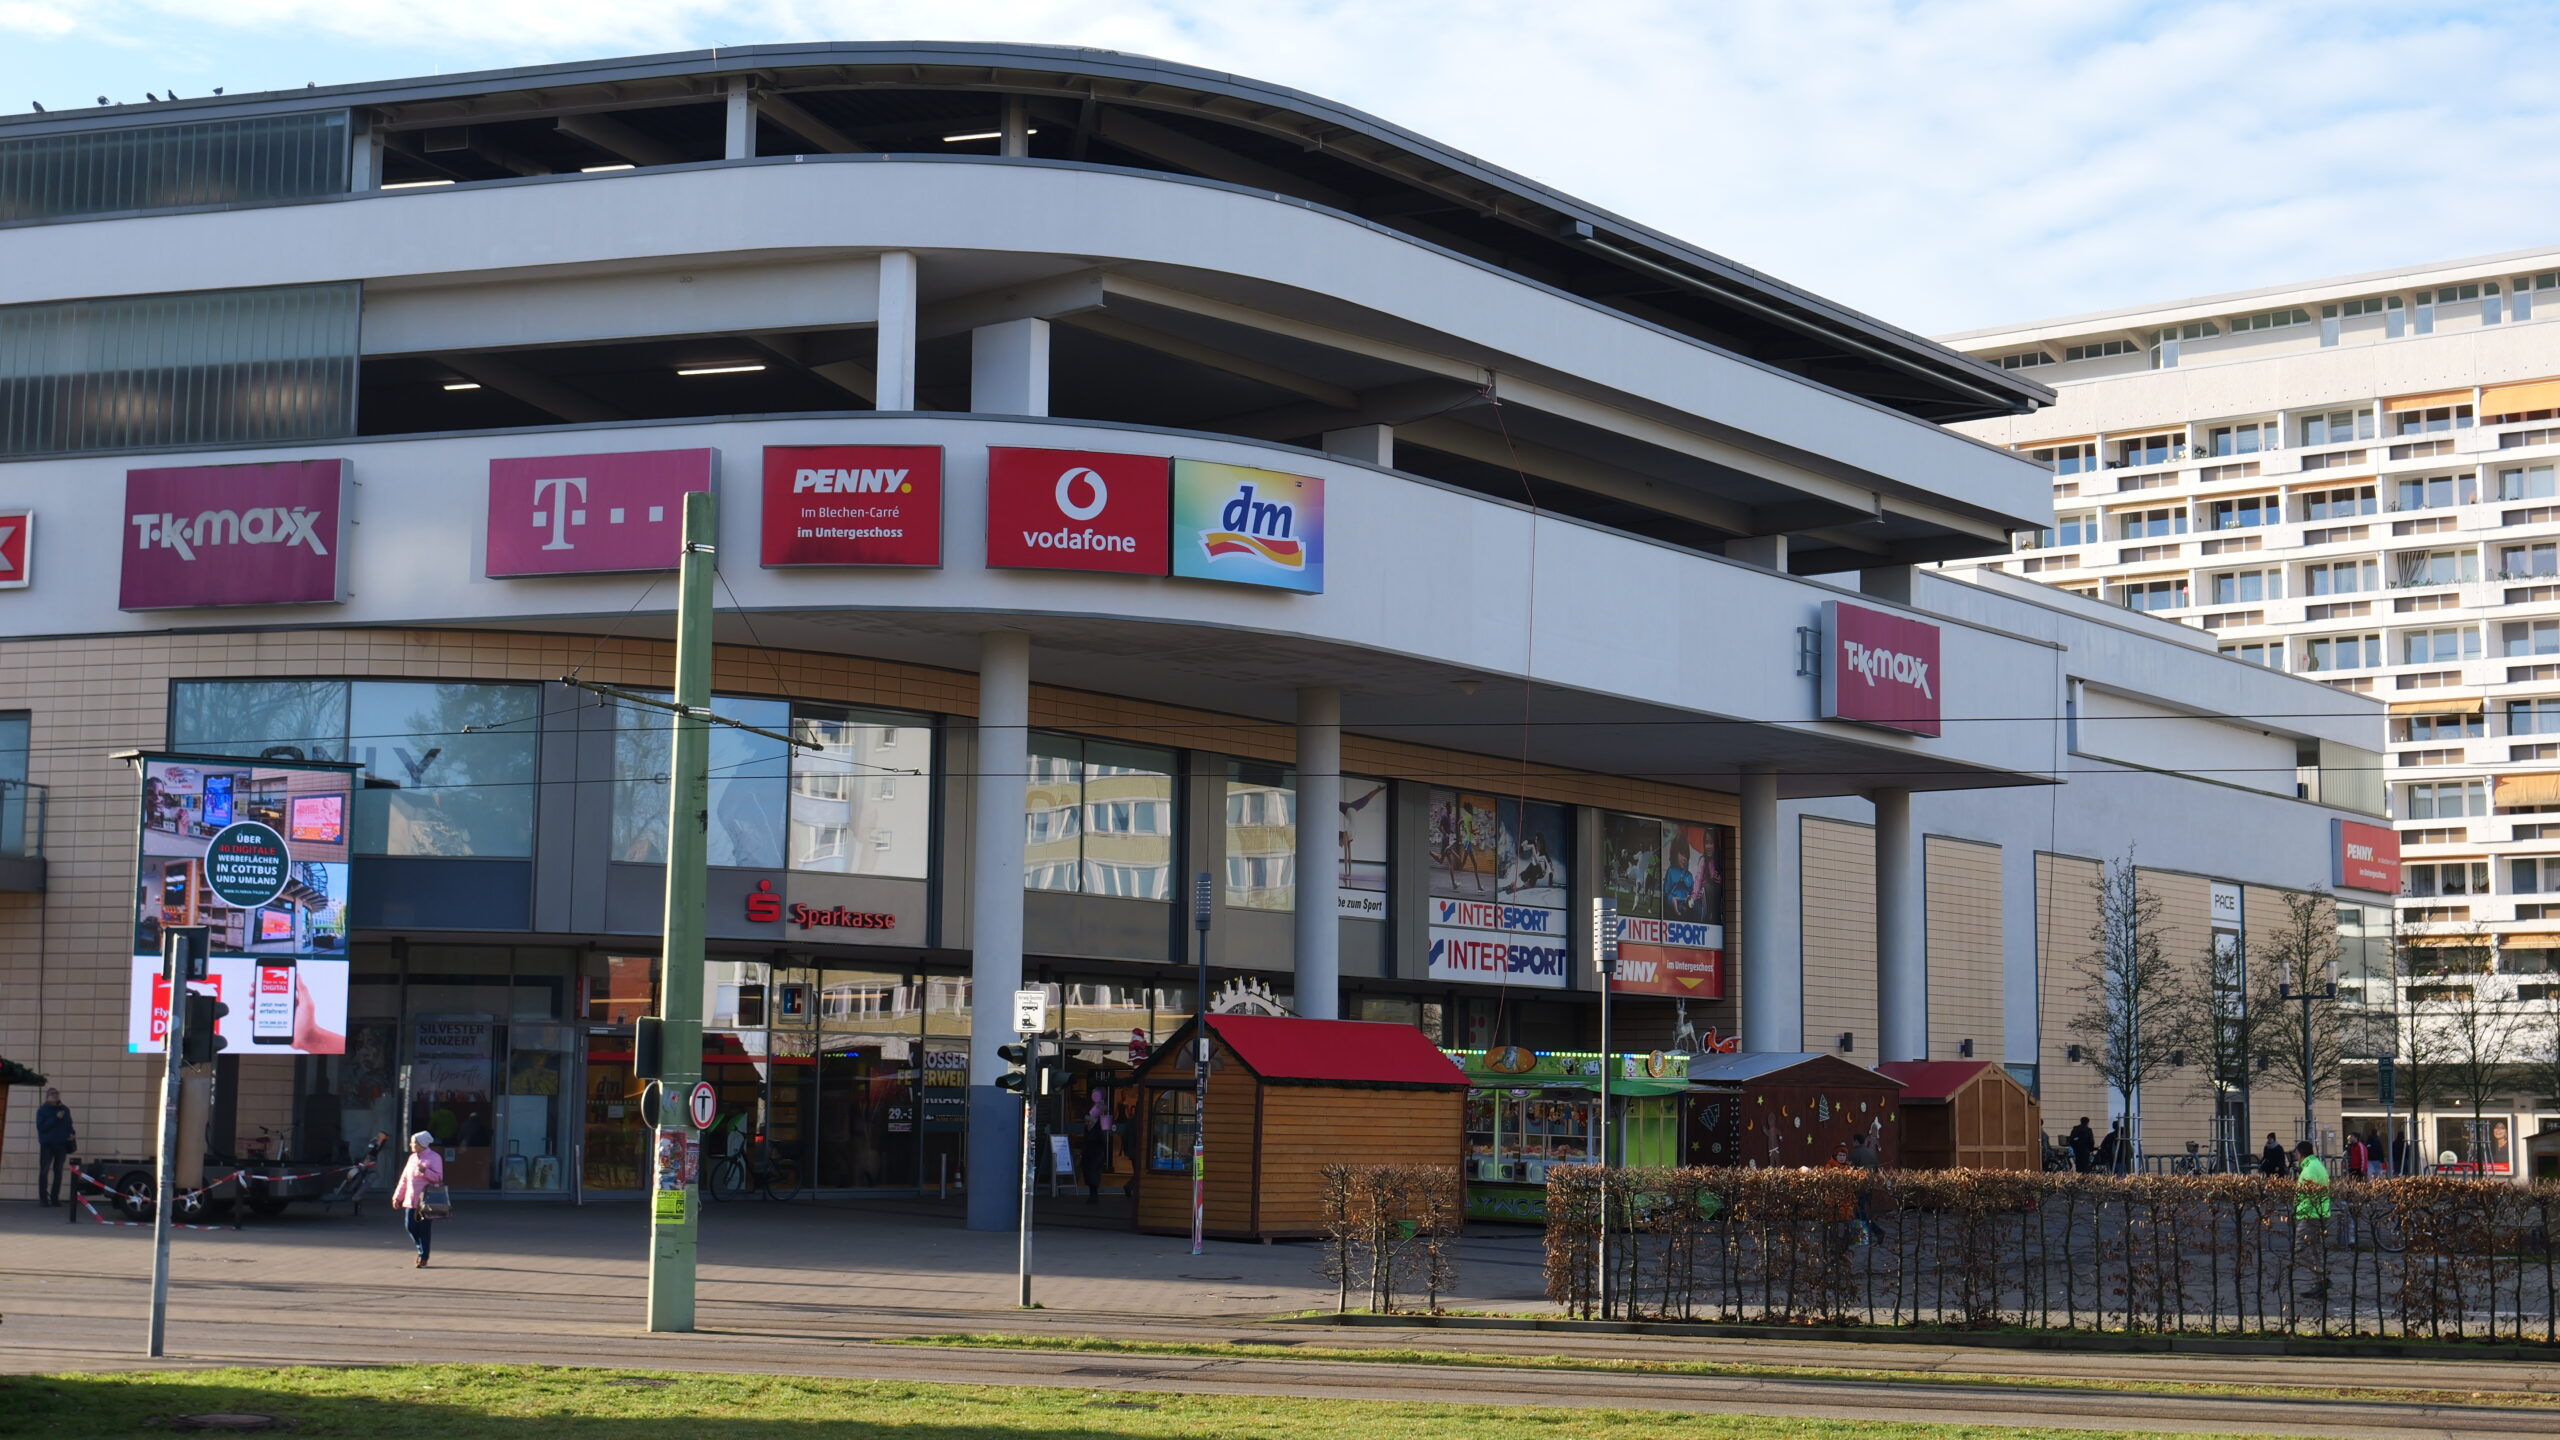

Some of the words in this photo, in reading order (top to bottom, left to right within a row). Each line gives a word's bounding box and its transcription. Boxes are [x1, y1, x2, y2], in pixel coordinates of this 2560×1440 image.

[801, 507, 816, 518] Im
[819, 505, 900, 518] Blechen-Carré
[1222, 485, 1293, 538] dm
[797, 527, 813, 538] im
[815, 527, 904, 540] Untergeschoss
[1023, 528, 1137, 553] vodafone
[236, 832, 262, 844] ÜBER
[232, 845, 277, 855] DIGITALE
[217, 854, 280, 865] WERBEFLÄCHEN
[216, 863, 229, 873] IN
[231, 864, 278, 876] COTTBUS
[215, 874, 237, 884] UND
[238, 876, 277, 886] UMLAND
[1337, 896, 1348, 908] be
[1347, 899, 1362, 909] zum
[1363, 898, 1383, 912] Sport
[2214, 894, 2236, 910] PACE
[795, 902, 897, 930] Sparkasse
[1458, 902, 1549, 932] INTERSPORT
[1629, 919, 1708, 946] INTERSPORT
[1448, 939, 1566, 977] INTERSPORT
[1613, 959, 1660, 984] ENNY.
[1666, 960, 1675, 969] im
[1675, 961, 1715, 973] Untergeschoss
[419, 1023, 484, 1034] SILVESTER
[419, 1035, 477, 1046] KONZERT
